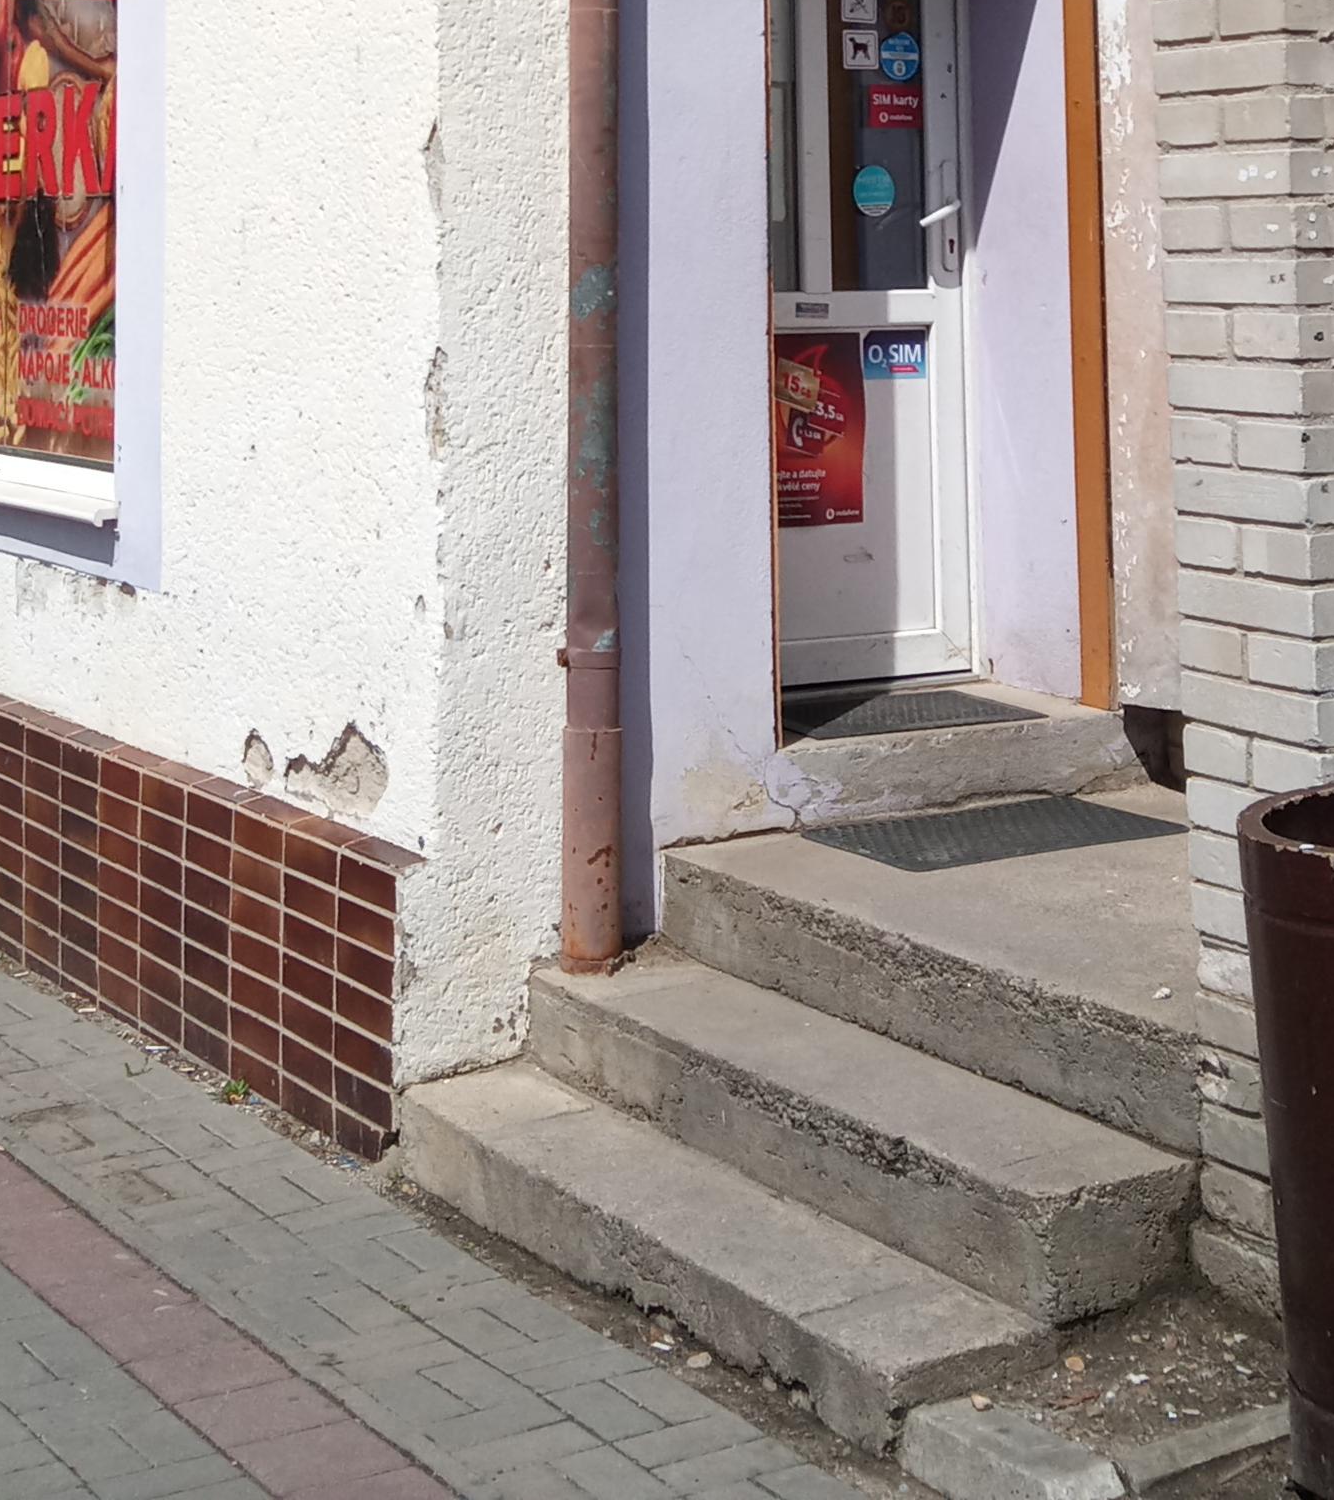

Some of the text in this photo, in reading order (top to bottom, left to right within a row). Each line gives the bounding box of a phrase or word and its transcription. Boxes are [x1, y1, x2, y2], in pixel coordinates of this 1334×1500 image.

[872, 93, 919, 109] SIM karty
[19, 304, 88, 339] DROGERIE
[889, 344, 922, 363] SIM
[781, 372, 800, 393] 15
